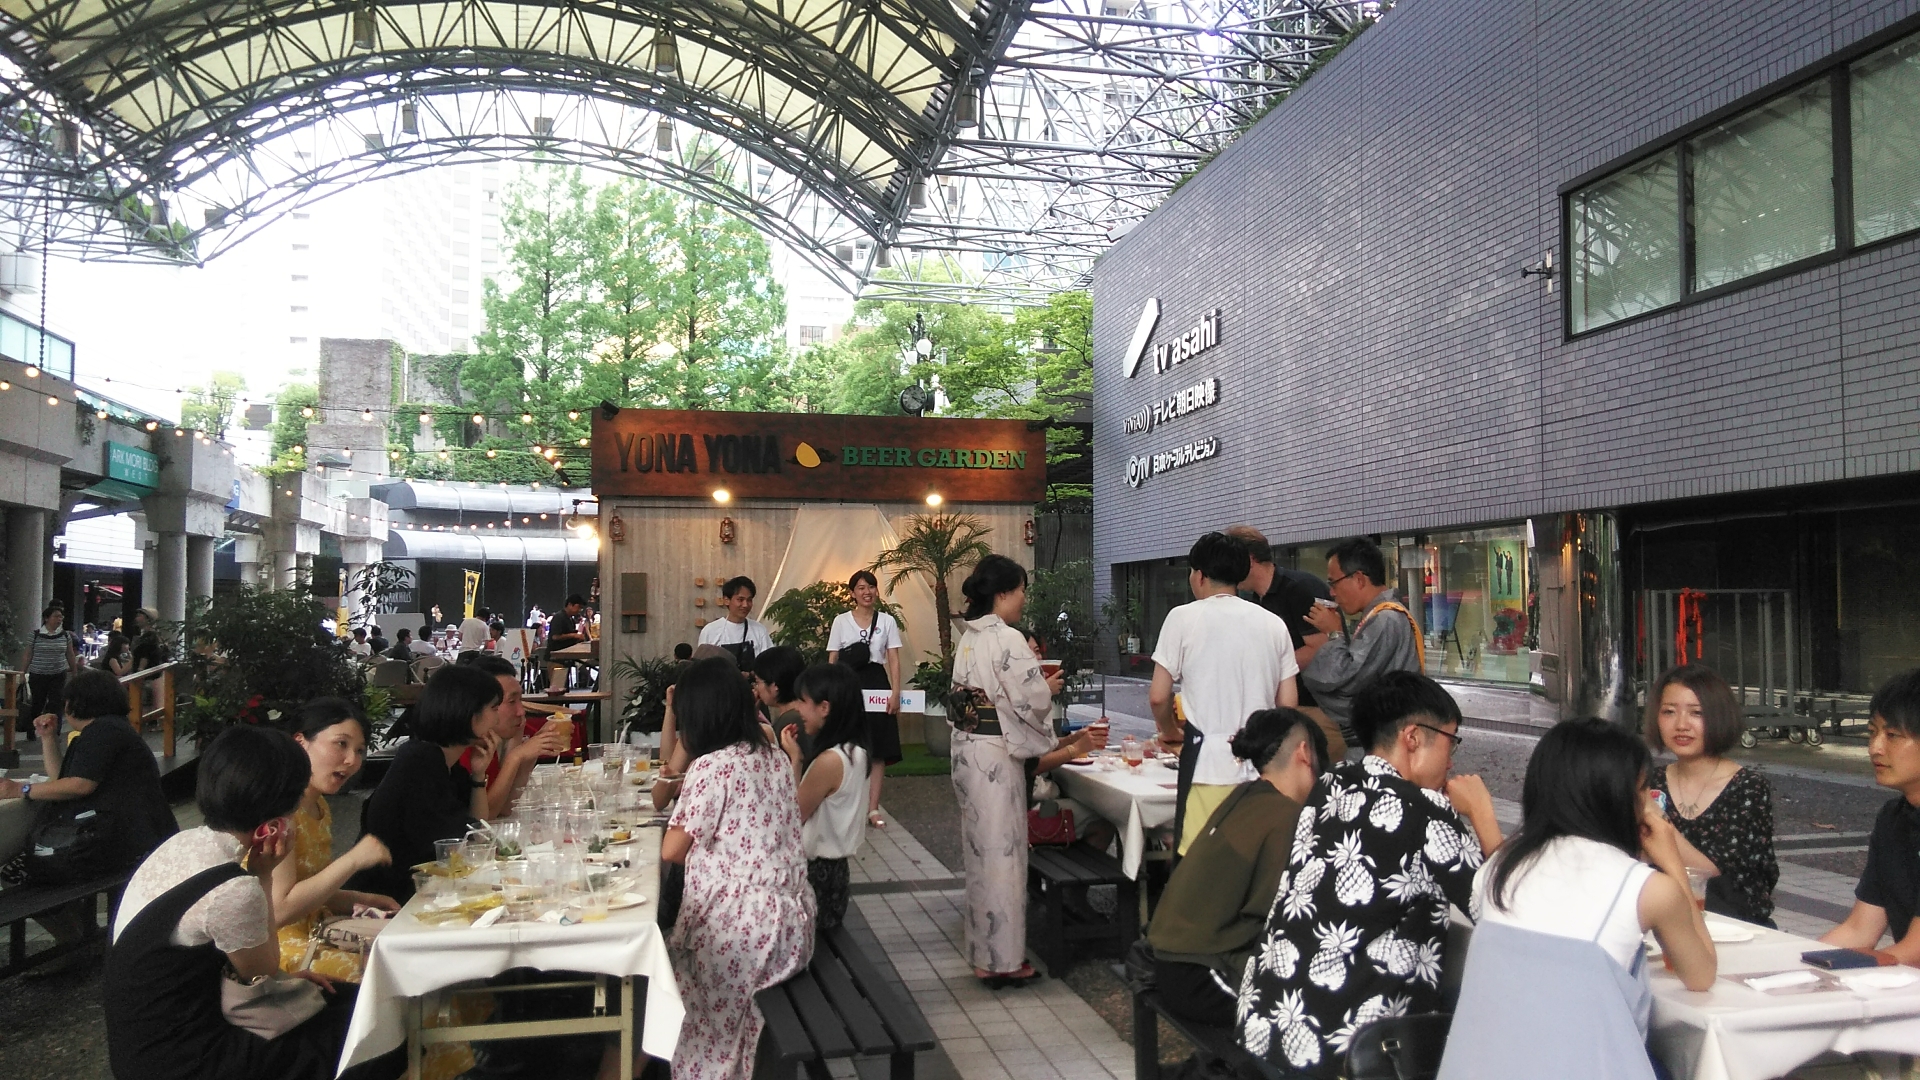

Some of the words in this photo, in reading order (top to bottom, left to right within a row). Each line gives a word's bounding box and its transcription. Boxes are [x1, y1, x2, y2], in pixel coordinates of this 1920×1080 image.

[1153, 342, 1170, 374] tv
[1172, 308, 1219, 367] asahi
[1153, 377, 1216, 425] テレビ朝日映像
[111, 448, 125, 464] ARK
[125, 452, 142, 469] MORI
[614, 433, 699, 474] YONA
[703, 434, 782, 474] YONA
[842, 446, 914, 468] BEER
[916, 448, 1027, 470] GARDEN
[1153, 436, 1217, 474] 日本ケーブルテレビジョン
